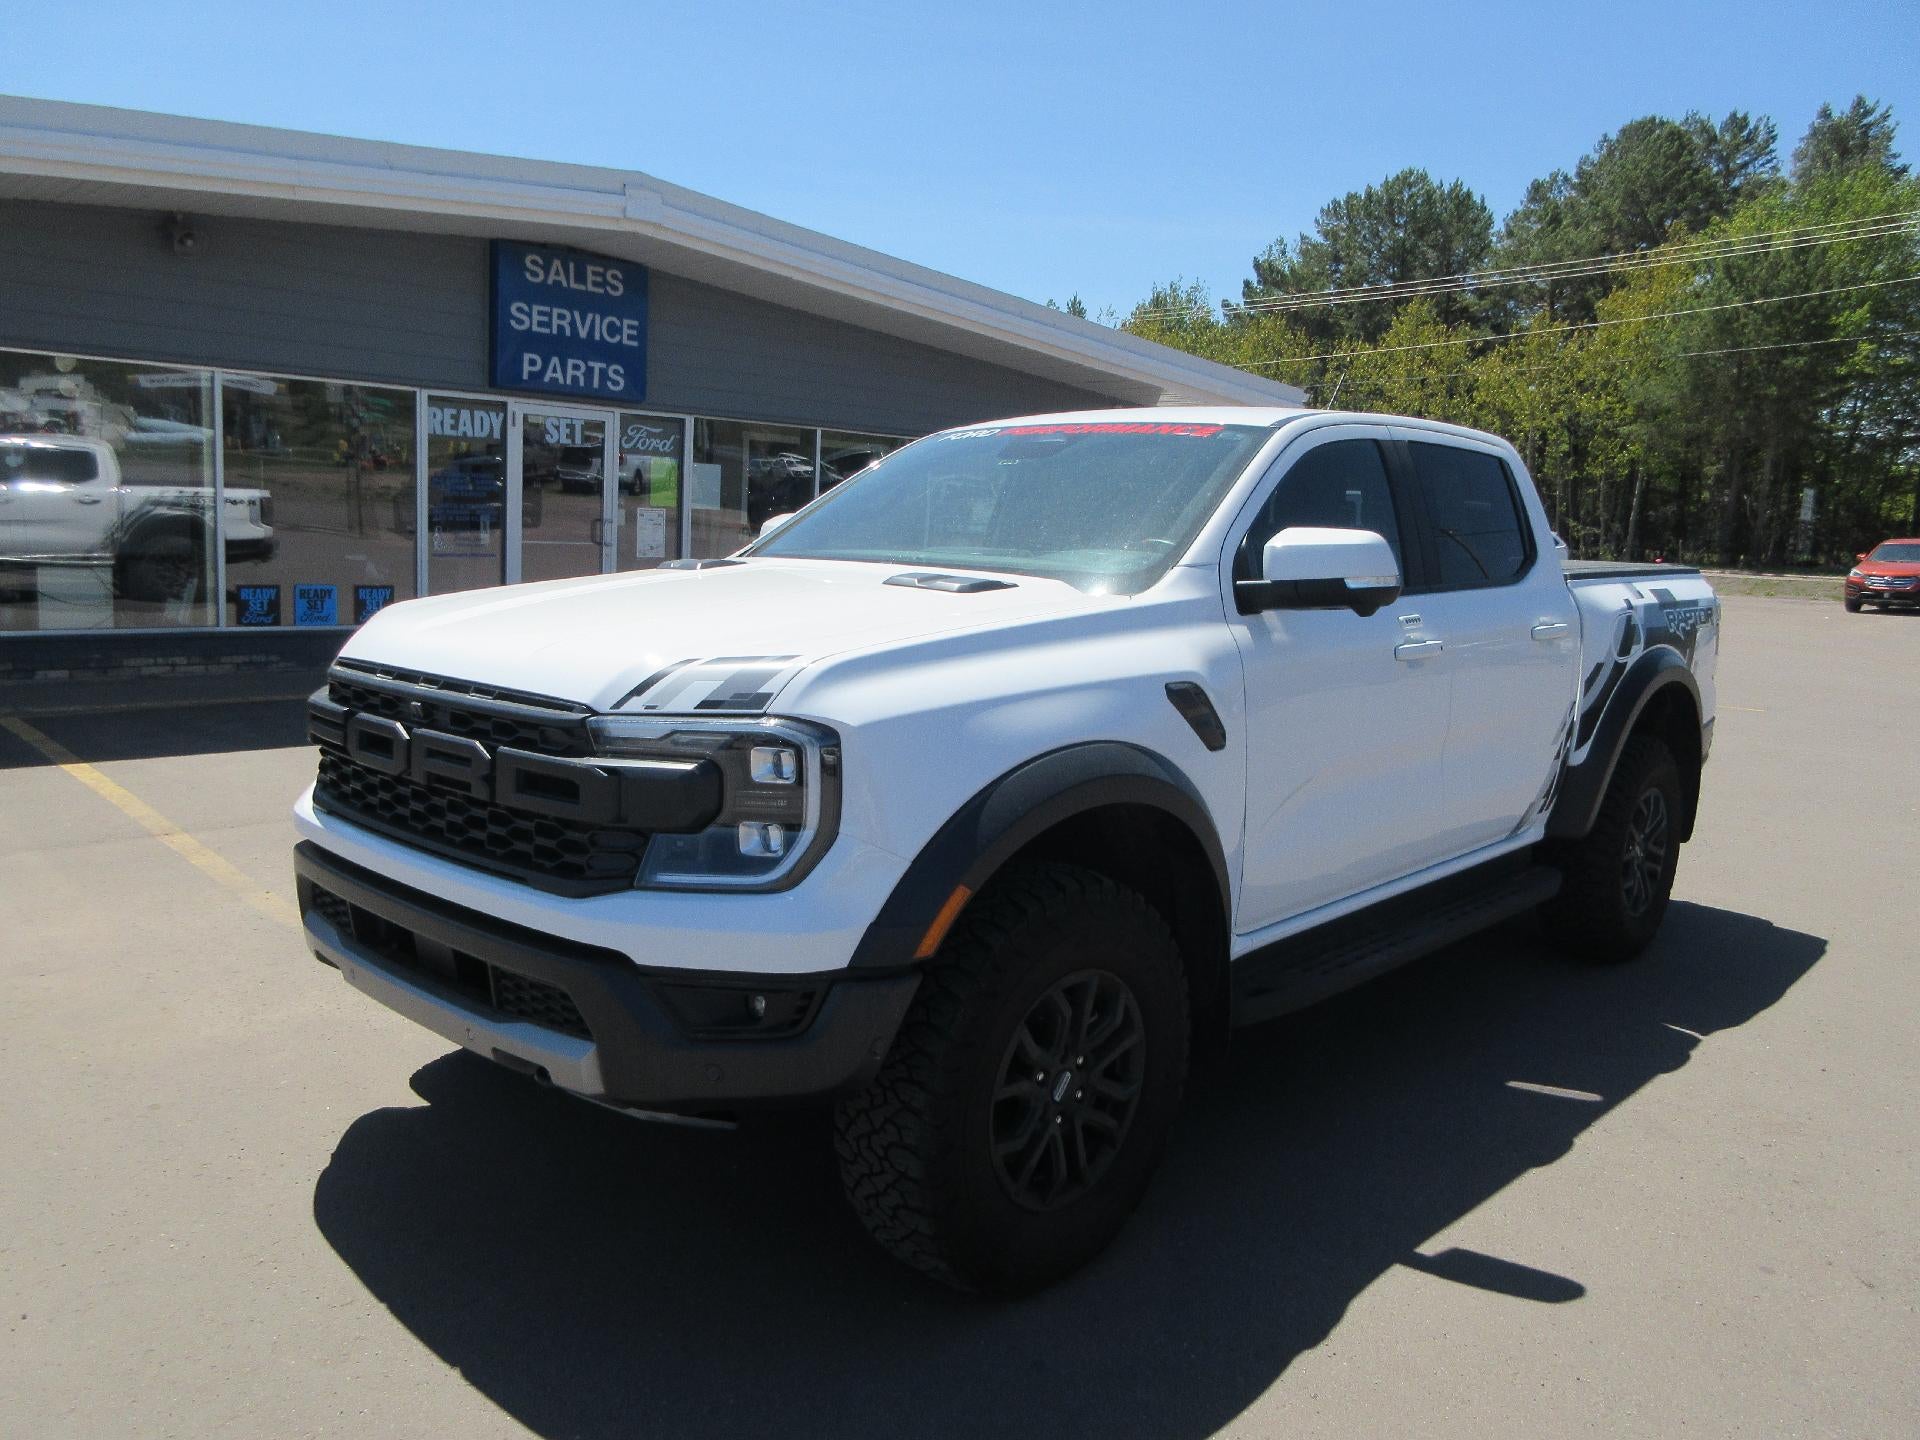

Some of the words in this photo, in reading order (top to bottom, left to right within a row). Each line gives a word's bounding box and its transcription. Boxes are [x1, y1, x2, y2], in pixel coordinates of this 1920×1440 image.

[525, 254, 624, 296] SALES
[510, 302, 639, 347] SERVICE
[522, 352, 625, 391] PARTS
[428, 407, 504, 439] READY
[545, 418, 585, 444] SET
[622, 424, 676, 451] Ford
[240, 588, 277, 599] READY
[300, 588, 333, 599] READY
[359, 588, 391, 600] READY
[249, 600, 269, 611] SET
[306, 600, 324, 611] SET
[1664, 606, 1713, 640] RAPTOR
